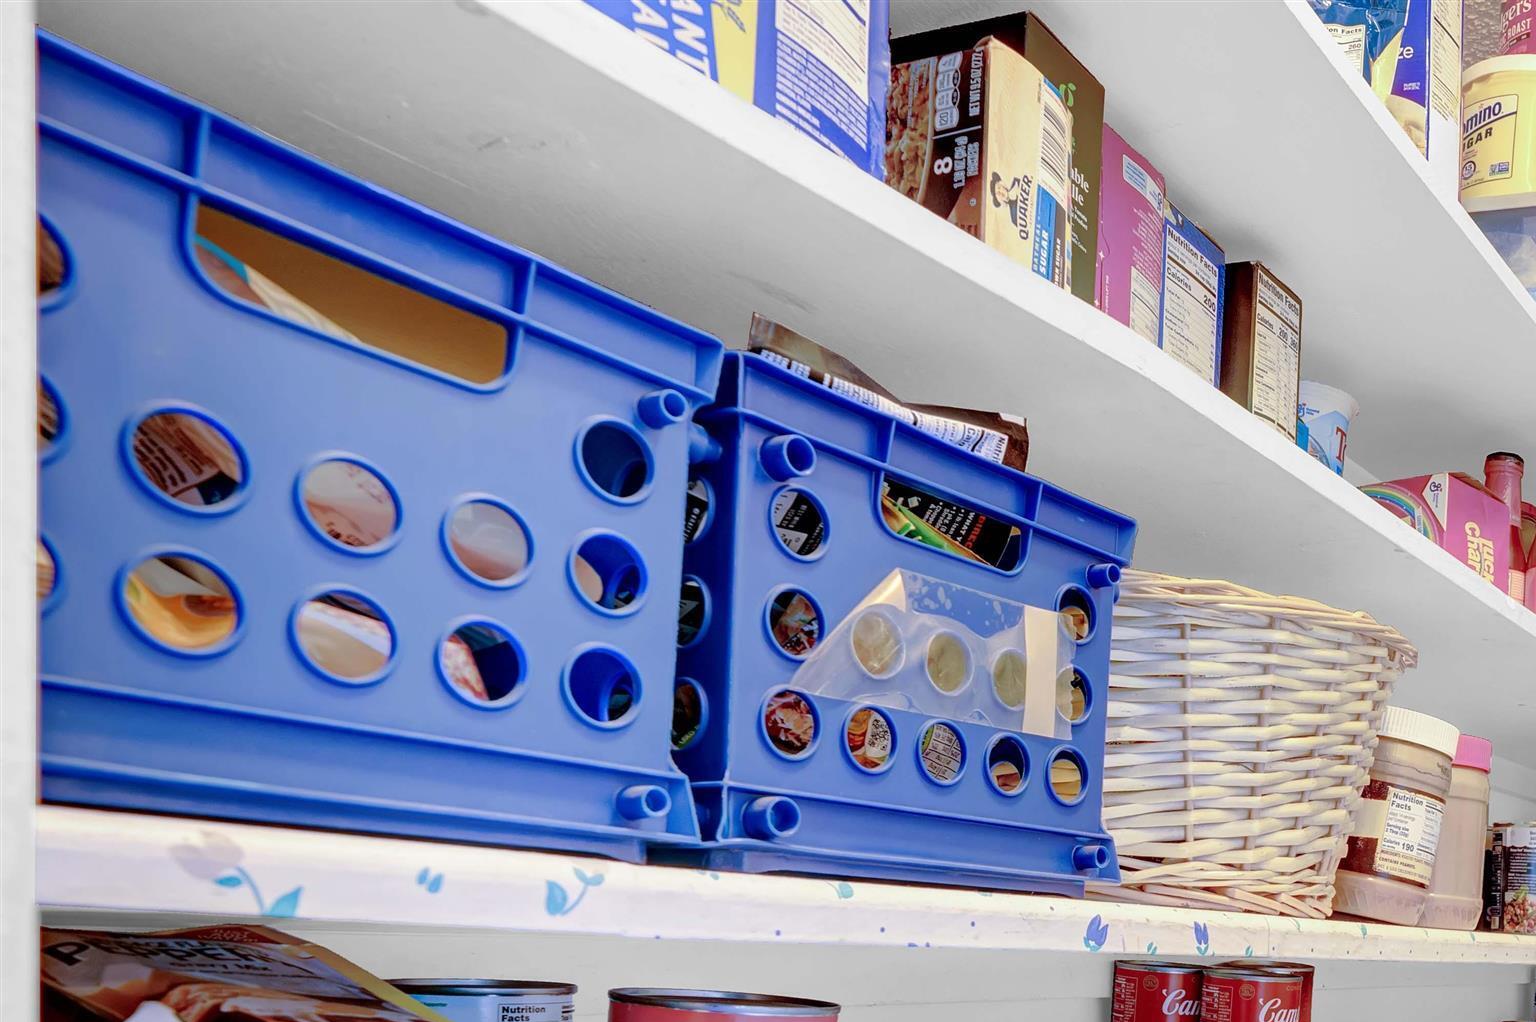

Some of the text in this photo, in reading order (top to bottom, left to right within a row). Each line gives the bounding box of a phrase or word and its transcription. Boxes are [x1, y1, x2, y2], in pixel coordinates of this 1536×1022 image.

[934, 156, 953, 175] 8
[1019, 175, 1032, 240] QUAKER
[1040, 231, 1049, 274] SUGAR
[1168, 229, 1218, 278] Nutrition Facts
[1166, 267, 1192, 291] Calories
[1203, 295, 1216, 312] 200
[1390, 801, 1412, 811] Facts
[1392, 792, 1424, 806] Nutrition
[1401, 842, 1415, 852] 190
[501, 1014, 530, 1022] Facts
[502, 1005, 545, 1014] Nutrition
